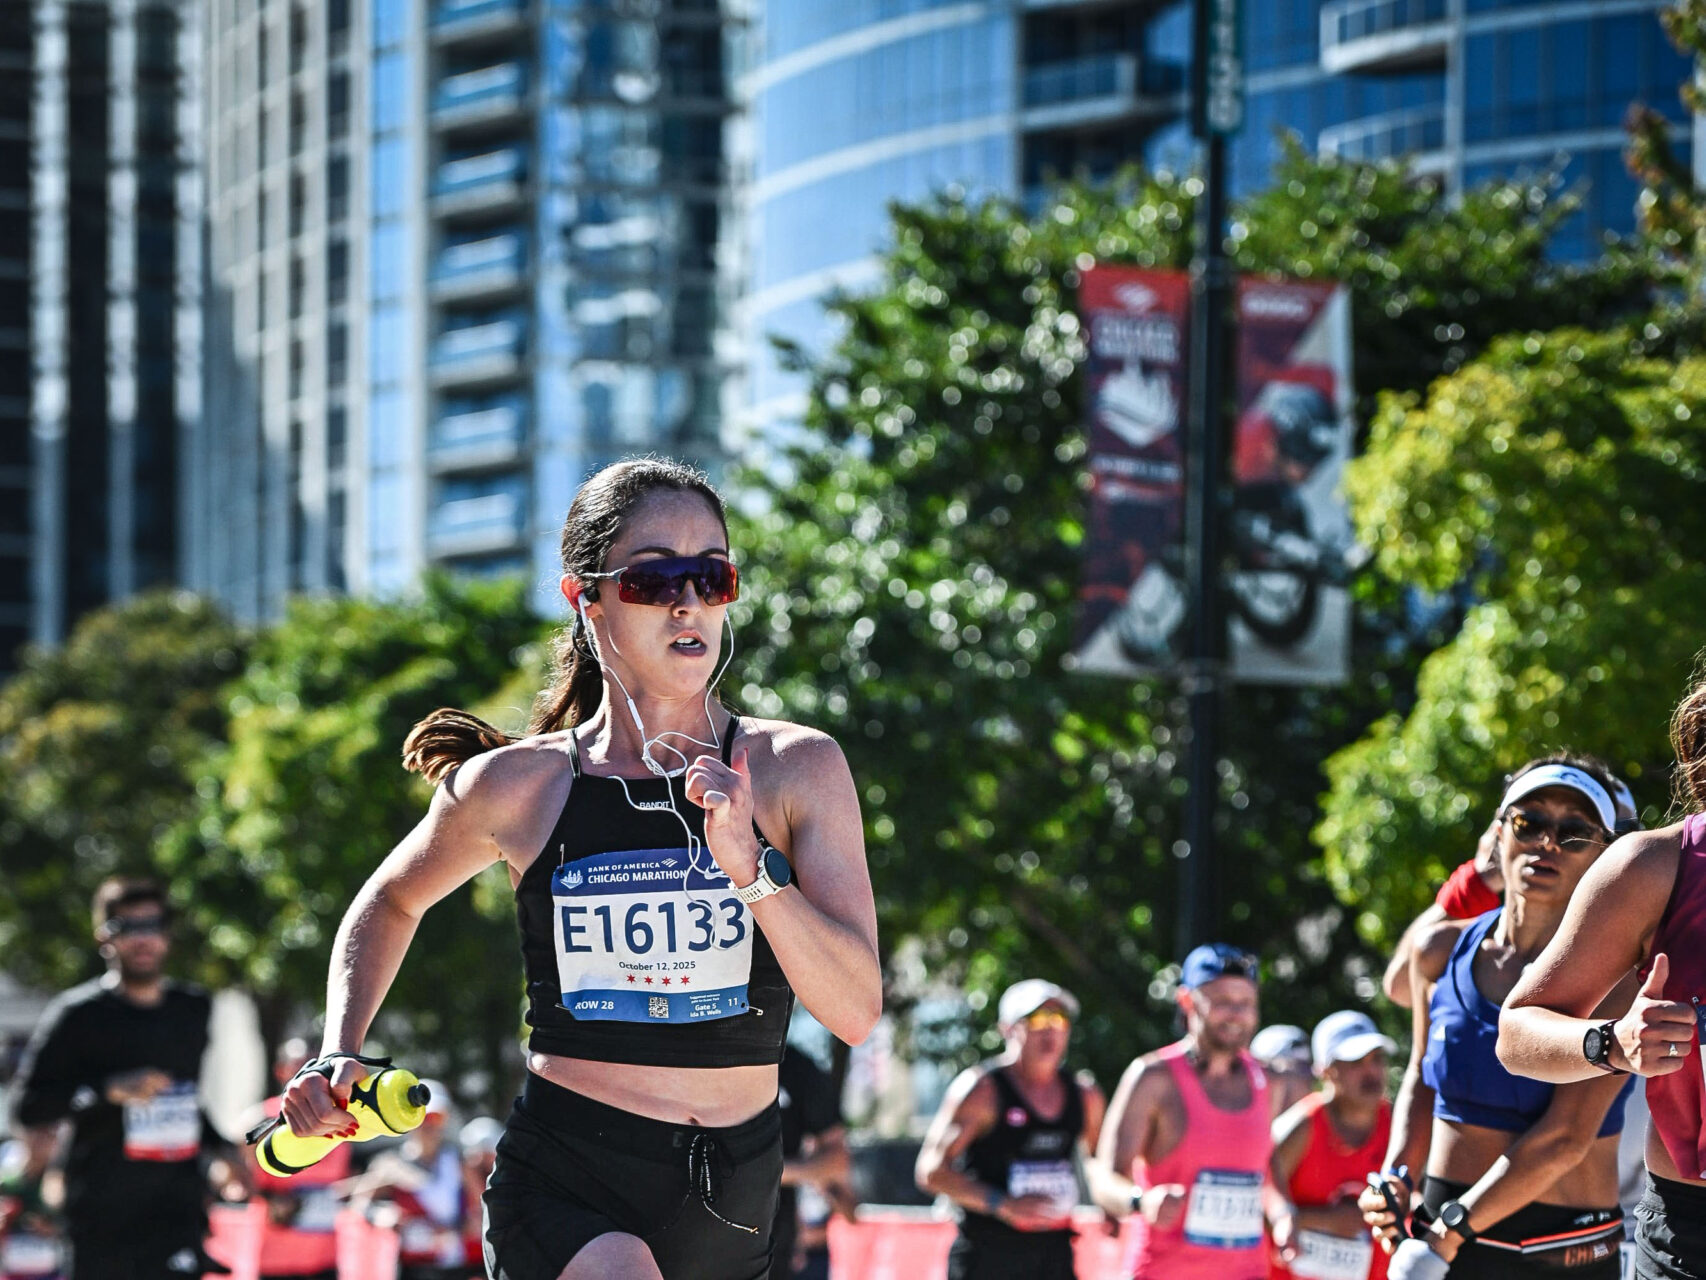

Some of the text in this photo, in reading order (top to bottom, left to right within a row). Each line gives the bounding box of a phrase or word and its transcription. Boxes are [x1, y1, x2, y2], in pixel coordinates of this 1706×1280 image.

[639, 801, 671, 809] BANDIT
[588, 865, 610, 873] BANK
[623, 862, 660, 870] AMERICA
[588, 870, 687, 884] CHICAGO MARATHON
[561, 897, 746, 955] E16133
[619, 961, 696, 972] October 12, 2025
[575, 1001, 614, 1011] ROW 28
